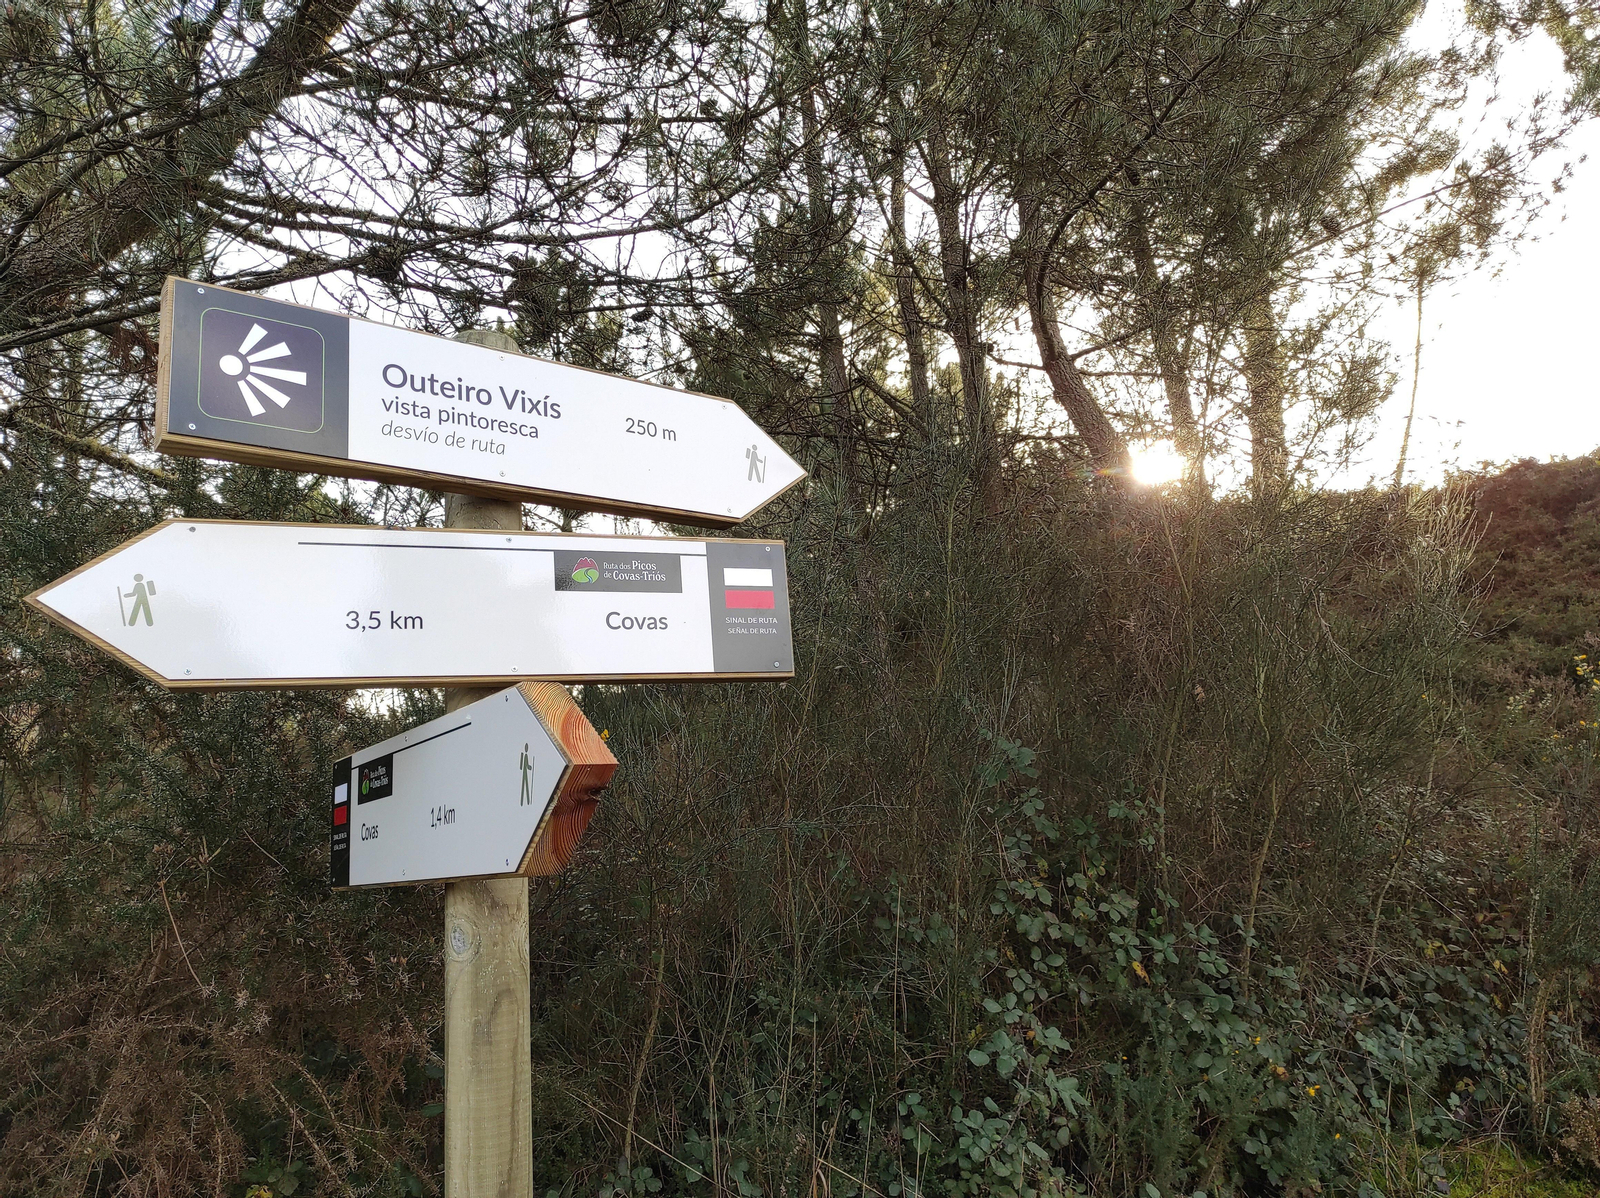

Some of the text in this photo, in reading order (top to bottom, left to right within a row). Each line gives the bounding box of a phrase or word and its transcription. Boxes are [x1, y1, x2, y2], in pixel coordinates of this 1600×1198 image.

[382, 363, 562, 420] Outeiro Vixís
[381, 396, 539, 439] vista pintoresca
[381, 419, 506, 456] desvío de ruta
[625, 417, 677, 442] 250 m
[603, 560, 657, 571] Ruta dos Picos
[603, 570, 666, 582] de Covas-Triós
[345, 610, 424, 632] 3,5 km
[605, 611, 669, 631] Covas
[725, 616, 747, 624] SINAL
[727, 626, 749, 634] SEÑAL
[430, 804, 456, 830] 1,4 km
[361, 823, 379, 841] Covas
